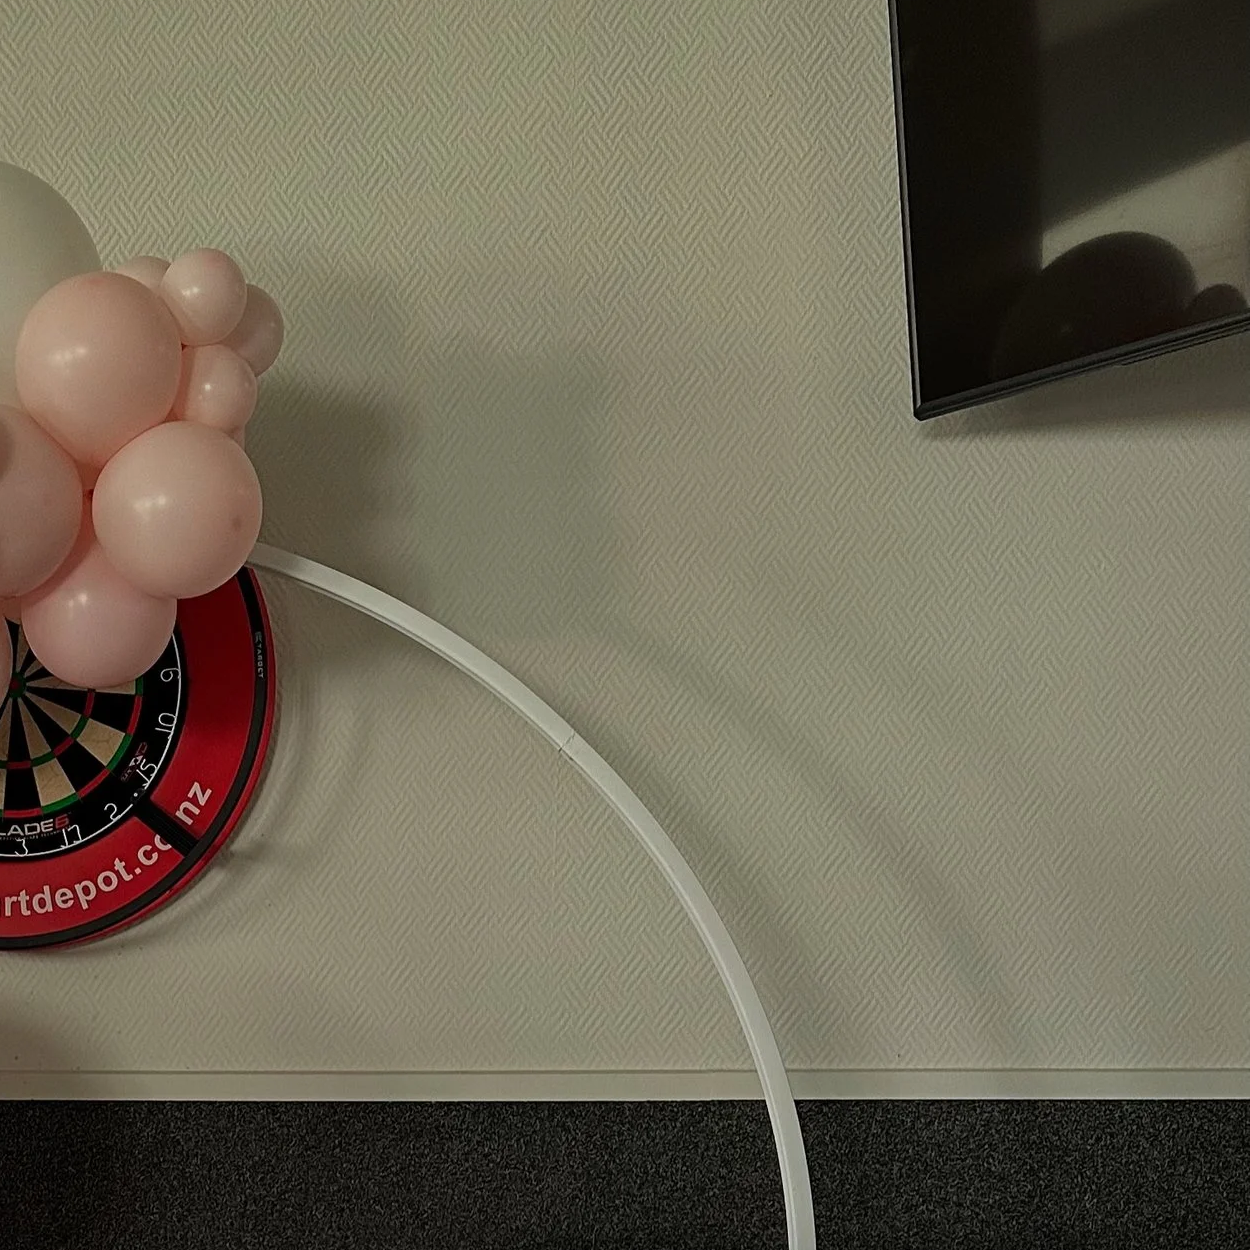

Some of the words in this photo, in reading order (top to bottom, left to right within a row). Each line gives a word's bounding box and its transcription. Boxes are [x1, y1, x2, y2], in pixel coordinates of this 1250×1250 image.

[14, 838, 29, 857] 3
[60, 824, 82, 848] 17
[103, 802, 121, 821] 2
[135, 758, 158, 787] 15
[154, 712, 177, 739] 10
